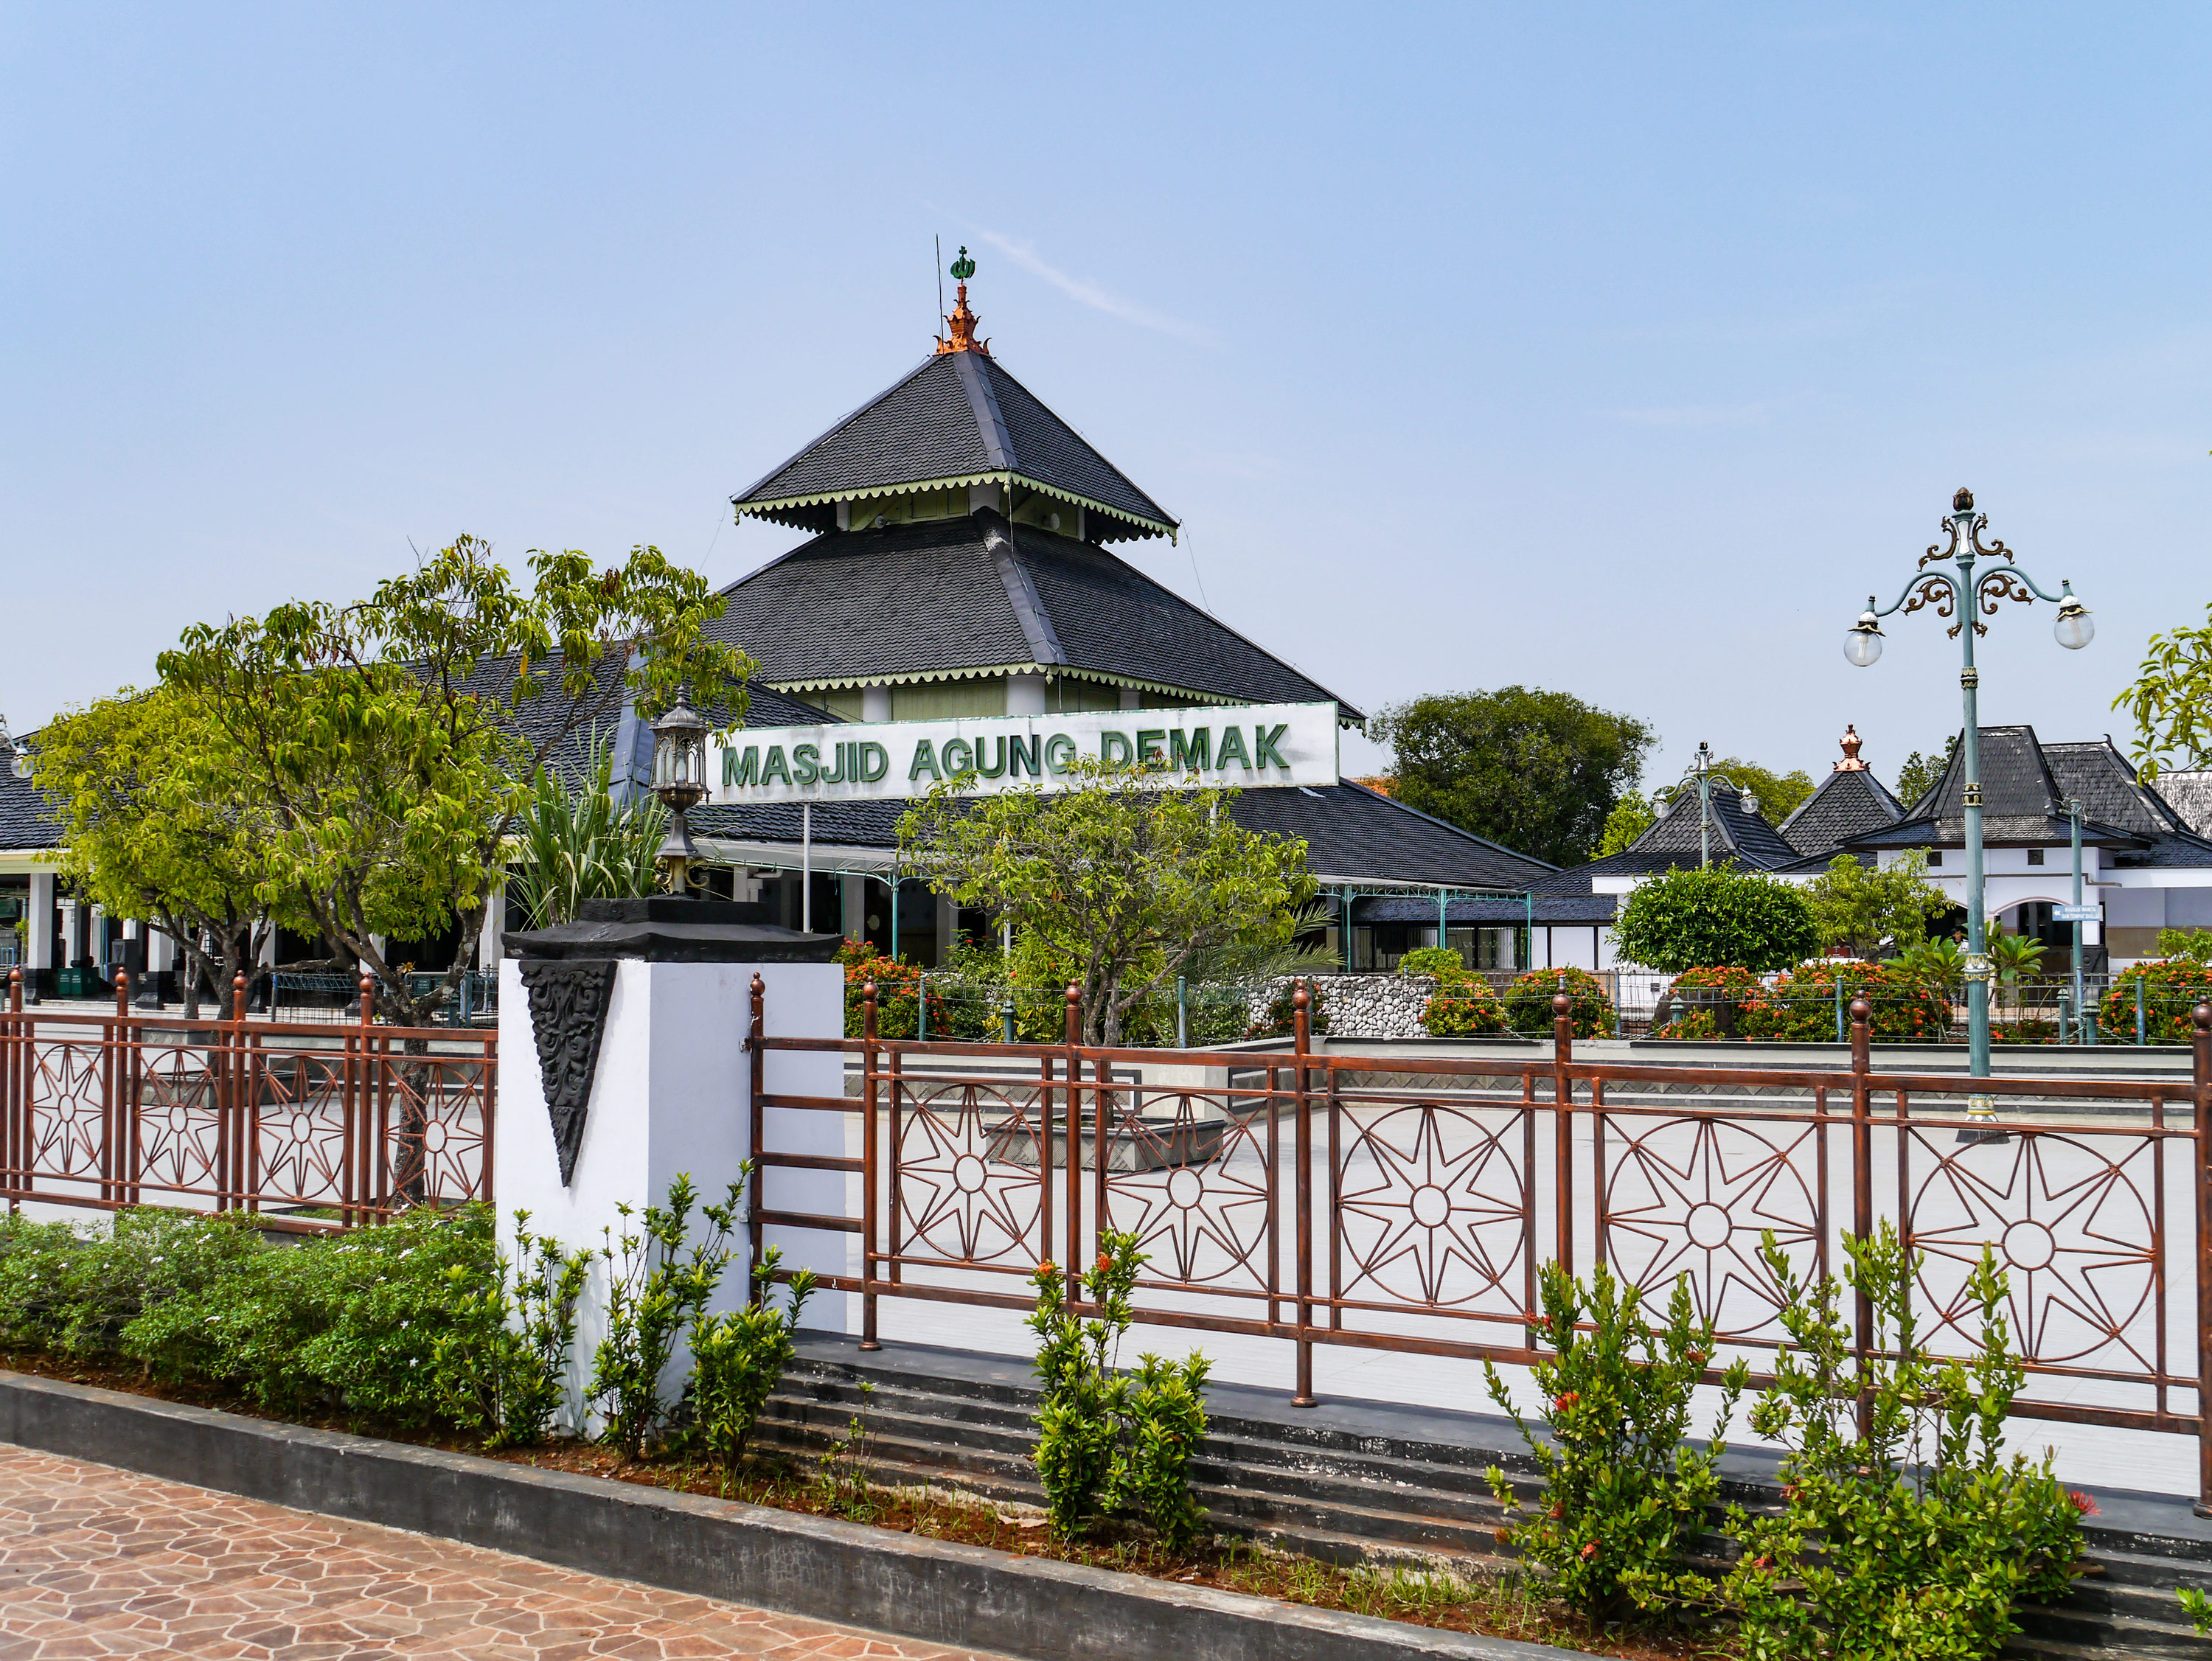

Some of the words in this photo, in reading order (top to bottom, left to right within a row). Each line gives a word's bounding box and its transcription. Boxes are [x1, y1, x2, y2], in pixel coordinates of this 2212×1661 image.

[722, 742, 888, 787] MASJID
[908, 732, 1076, 780] AGUNG
[1101, 723, 1290, 774] DEMAK
